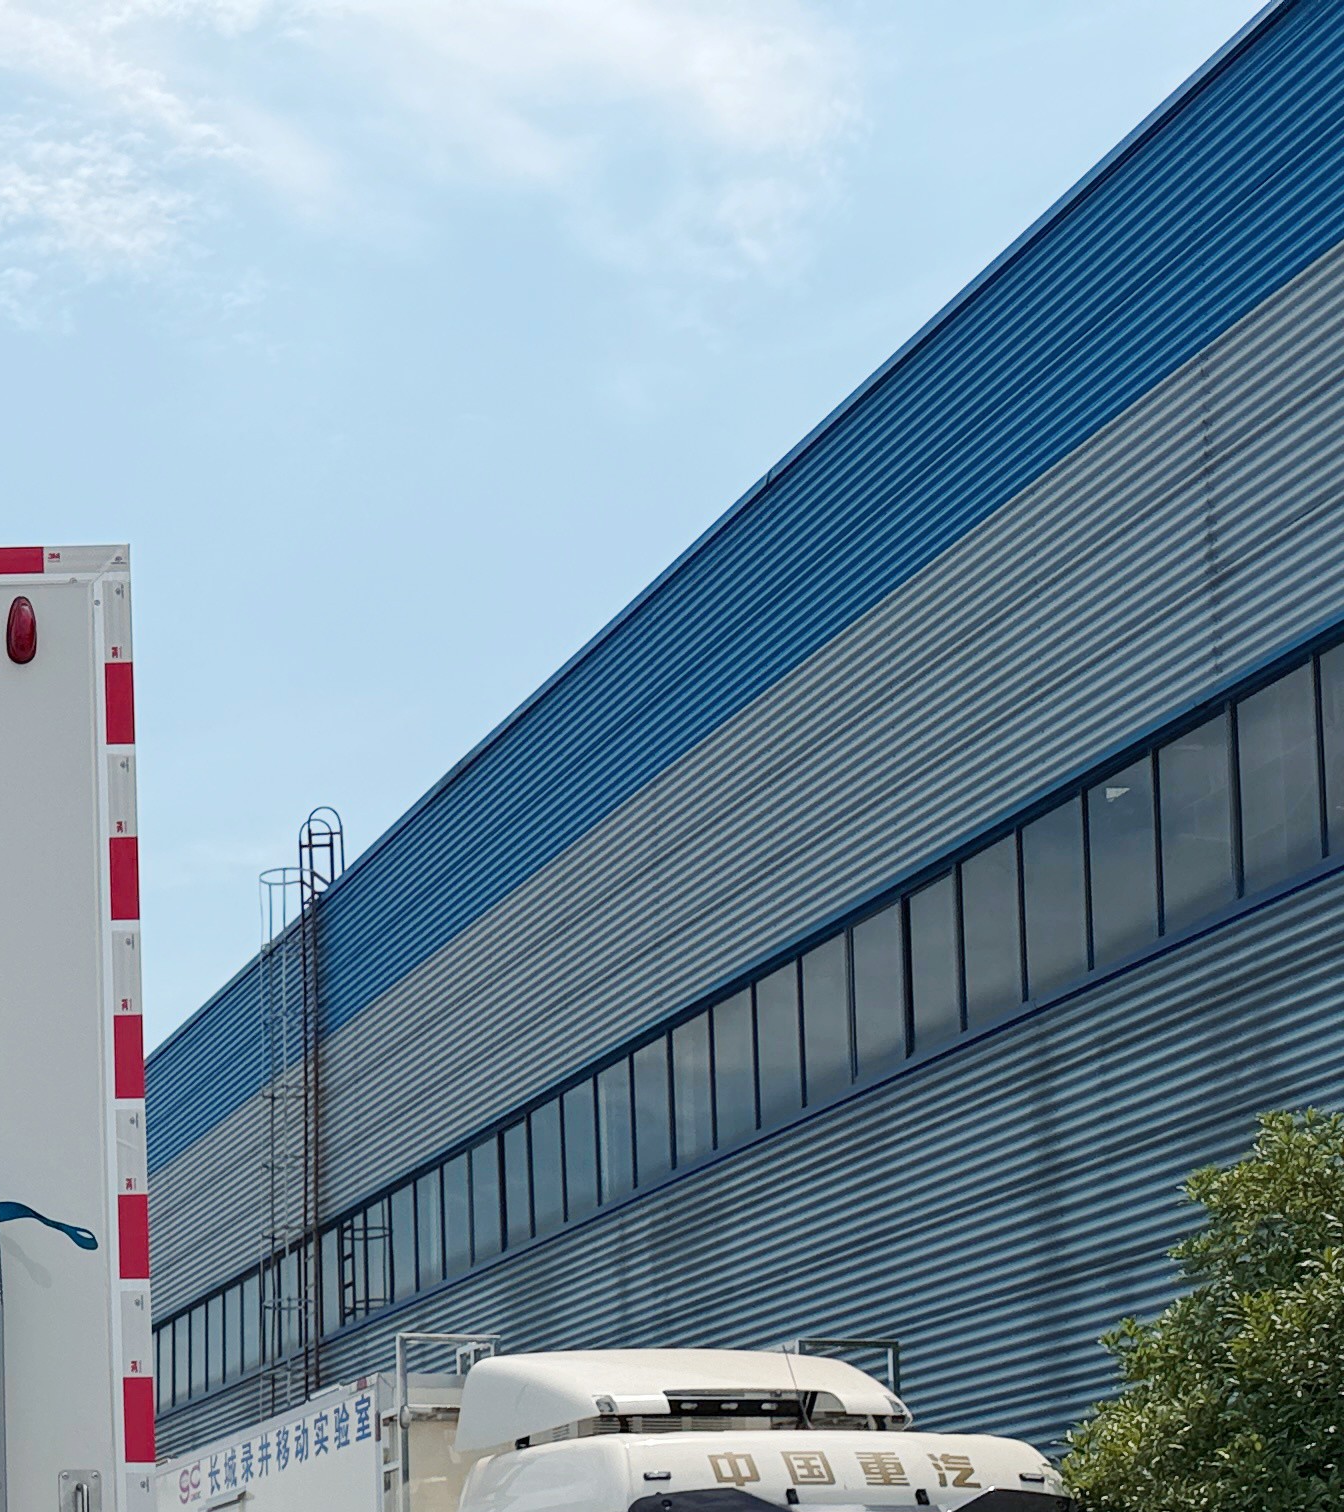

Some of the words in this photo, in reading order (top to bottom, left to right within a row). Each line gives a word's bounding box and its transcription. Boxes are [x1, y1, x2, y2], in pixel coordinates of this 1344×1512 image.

[208, 1394, 372, 1496] 长城录井移动实验室
[708, 1451, 982, 1487] 中国重汽
